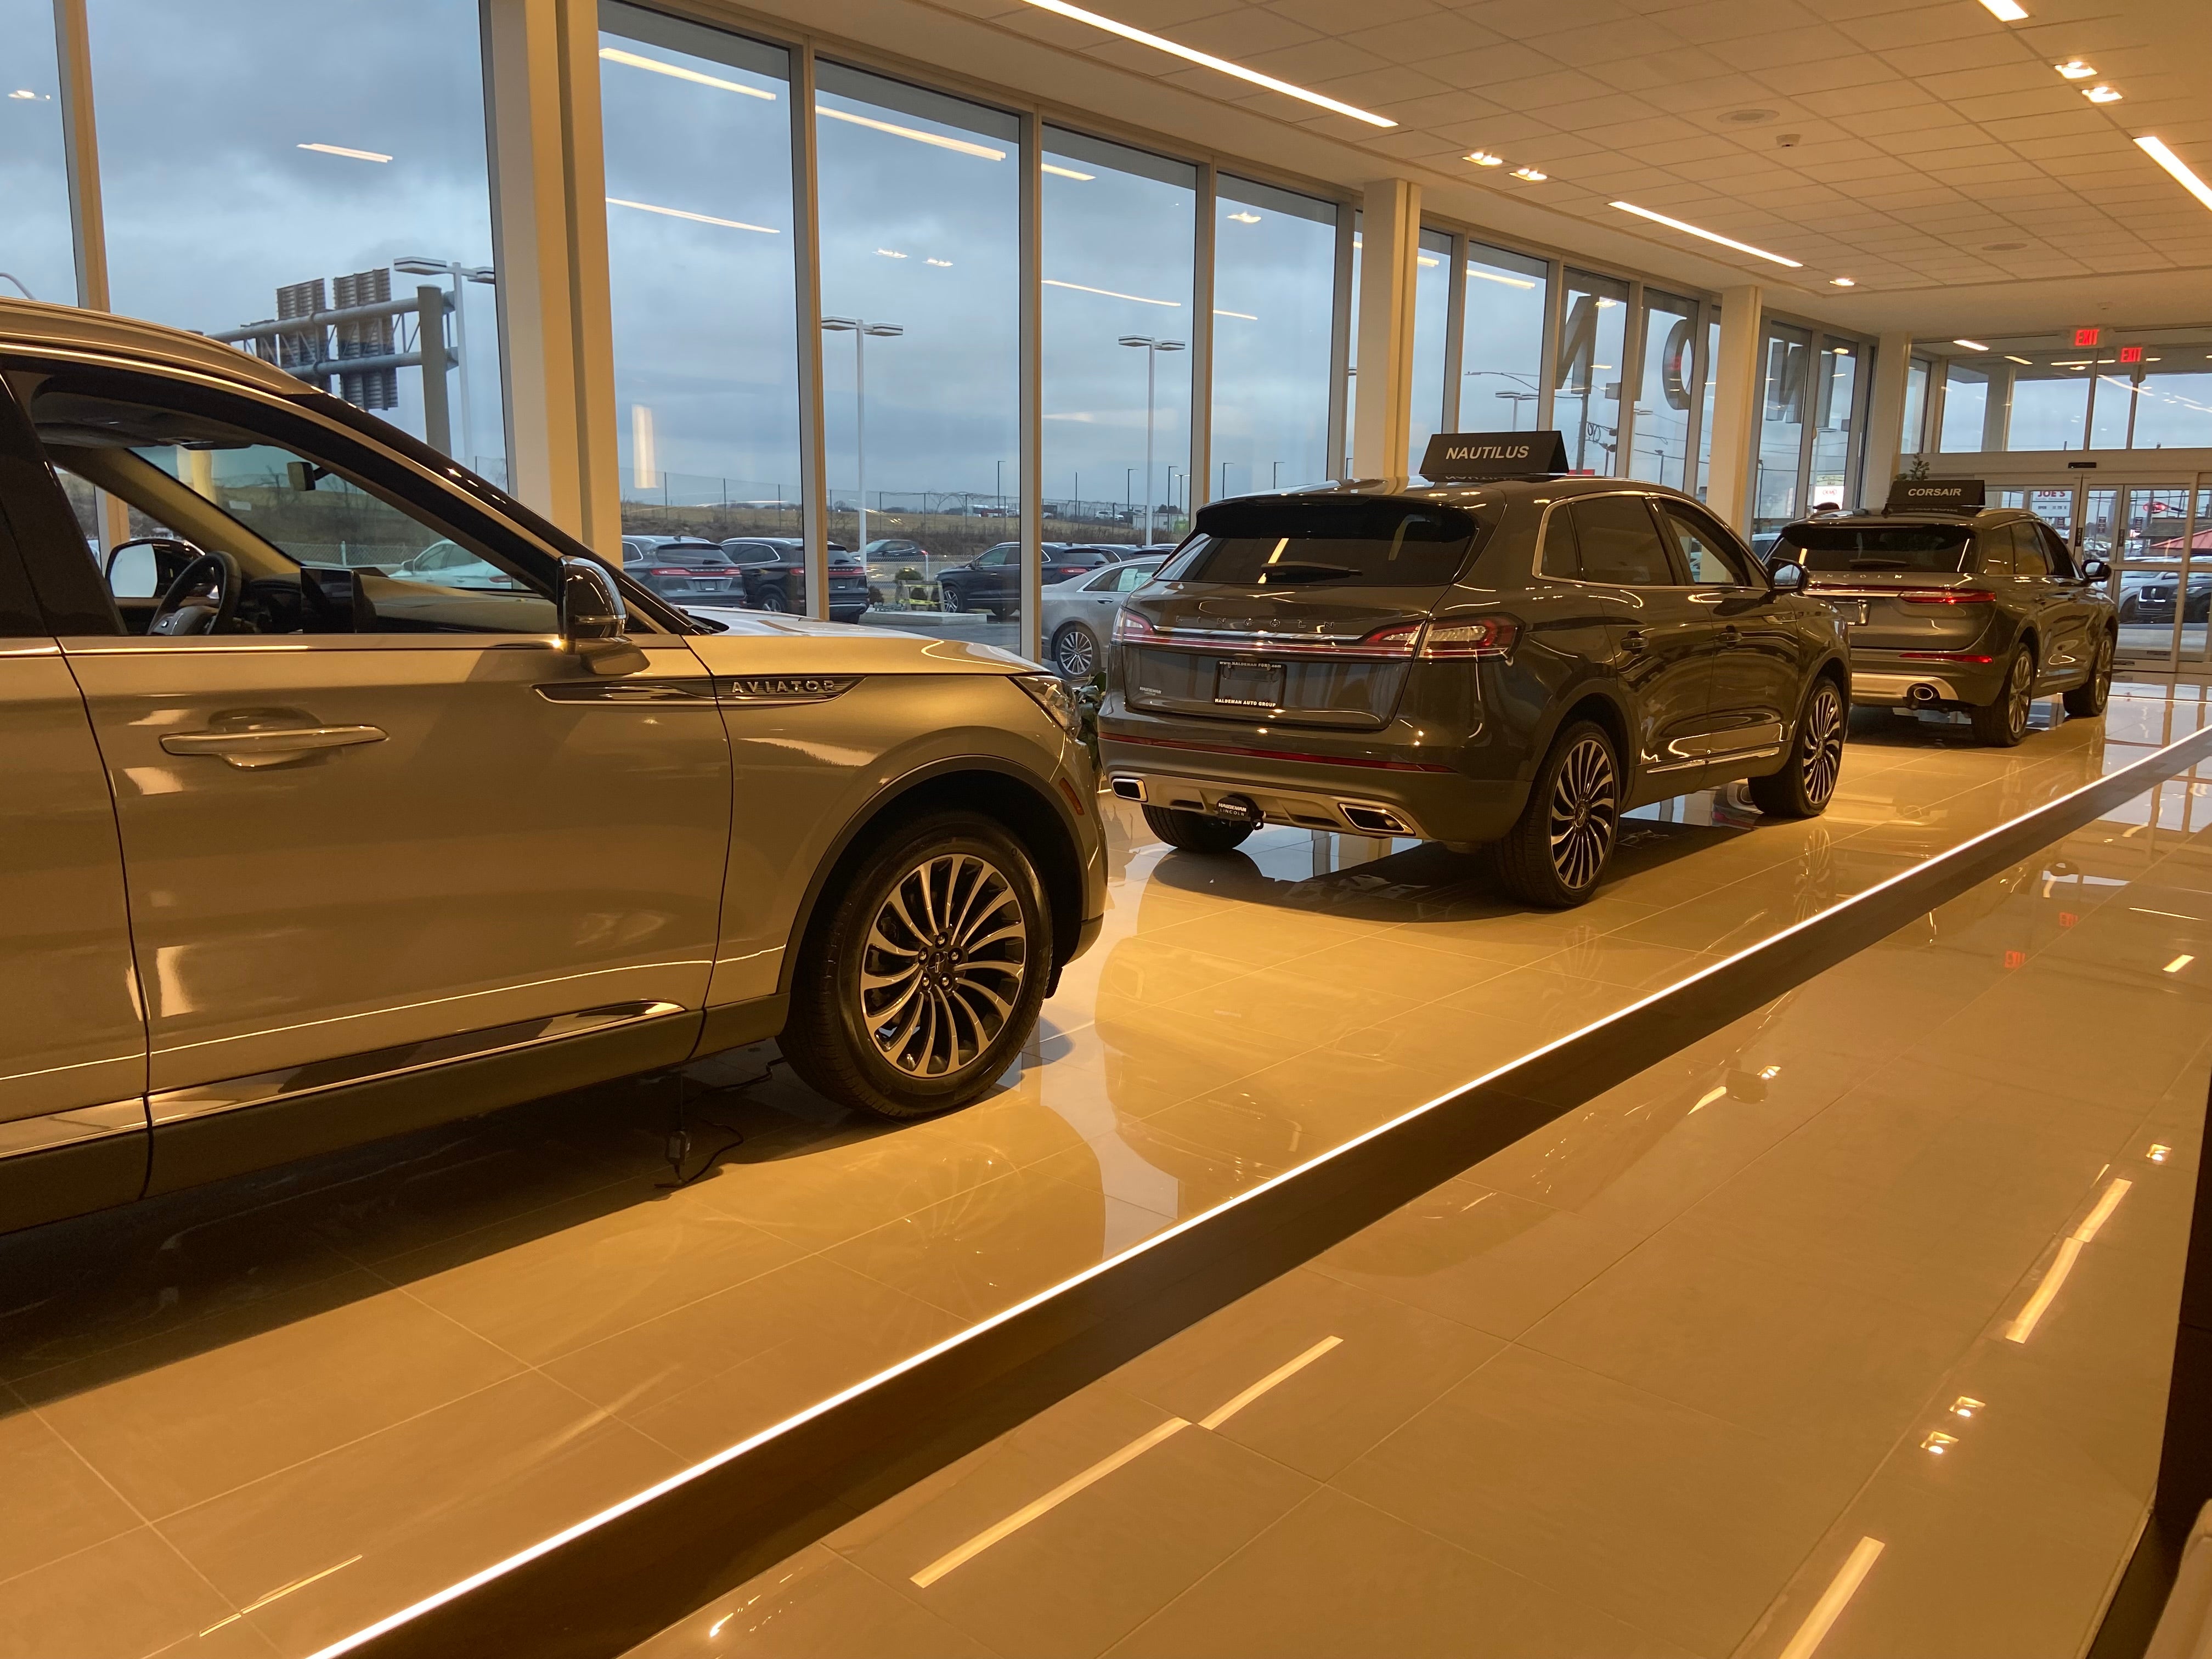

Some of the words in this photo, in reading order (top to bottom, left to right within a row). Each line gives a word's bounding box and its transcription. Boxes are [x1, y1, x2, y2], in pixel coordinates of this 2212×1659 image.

[2074, 329, 2100, 346] EXIT
[2120, 347, 2142, 363] EXIT
[1446, 445, 1530, 460] NAUTILUS
[1908, 488, 1962, 496] CORSAIR
[1176, 615, 1334, 629] LINCOLN
[731, 680, 835, 693] AVIATOR
[1220, 808, 1245, 816] LINCOLN
